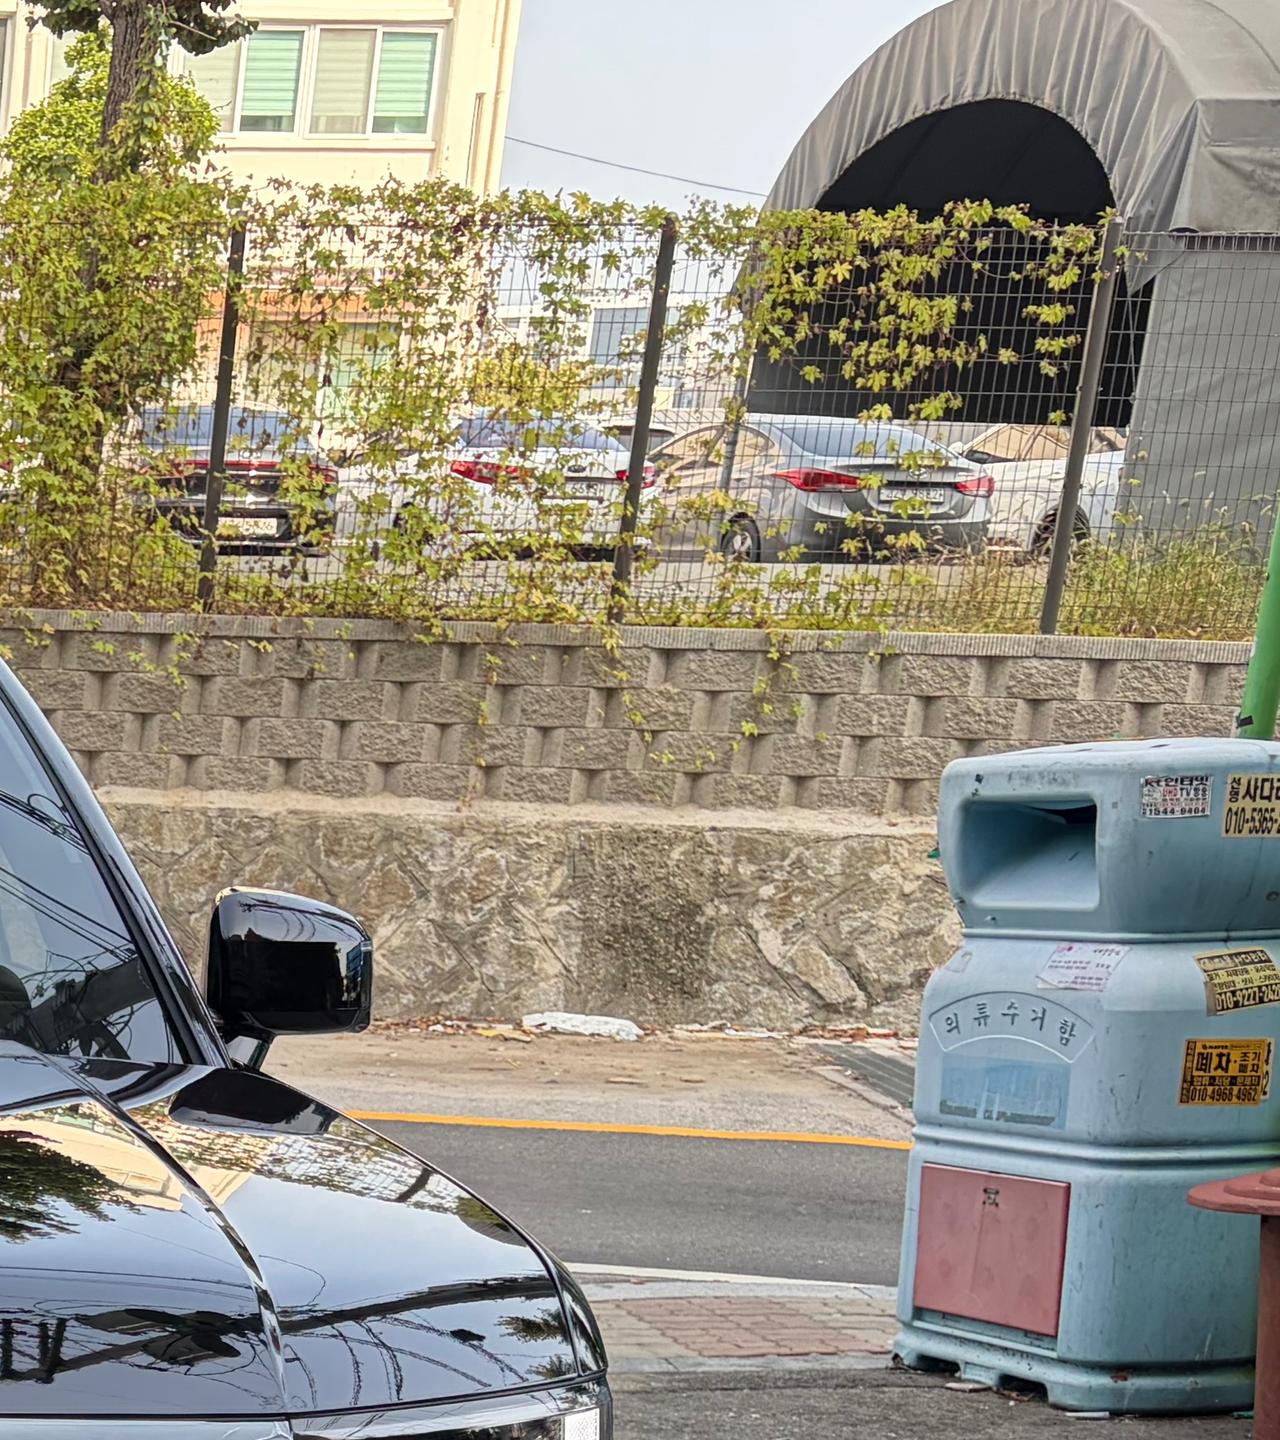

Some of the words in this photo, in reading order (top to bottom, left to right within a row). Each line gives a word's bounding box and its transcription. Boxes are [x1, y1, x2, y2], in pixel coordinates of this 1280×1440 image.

[1241, 777, 1280, 803] 사다
[1224, 806, 1280, 835] 010-5365-
[945, 1001, 1077, 1047] 의류수거함
